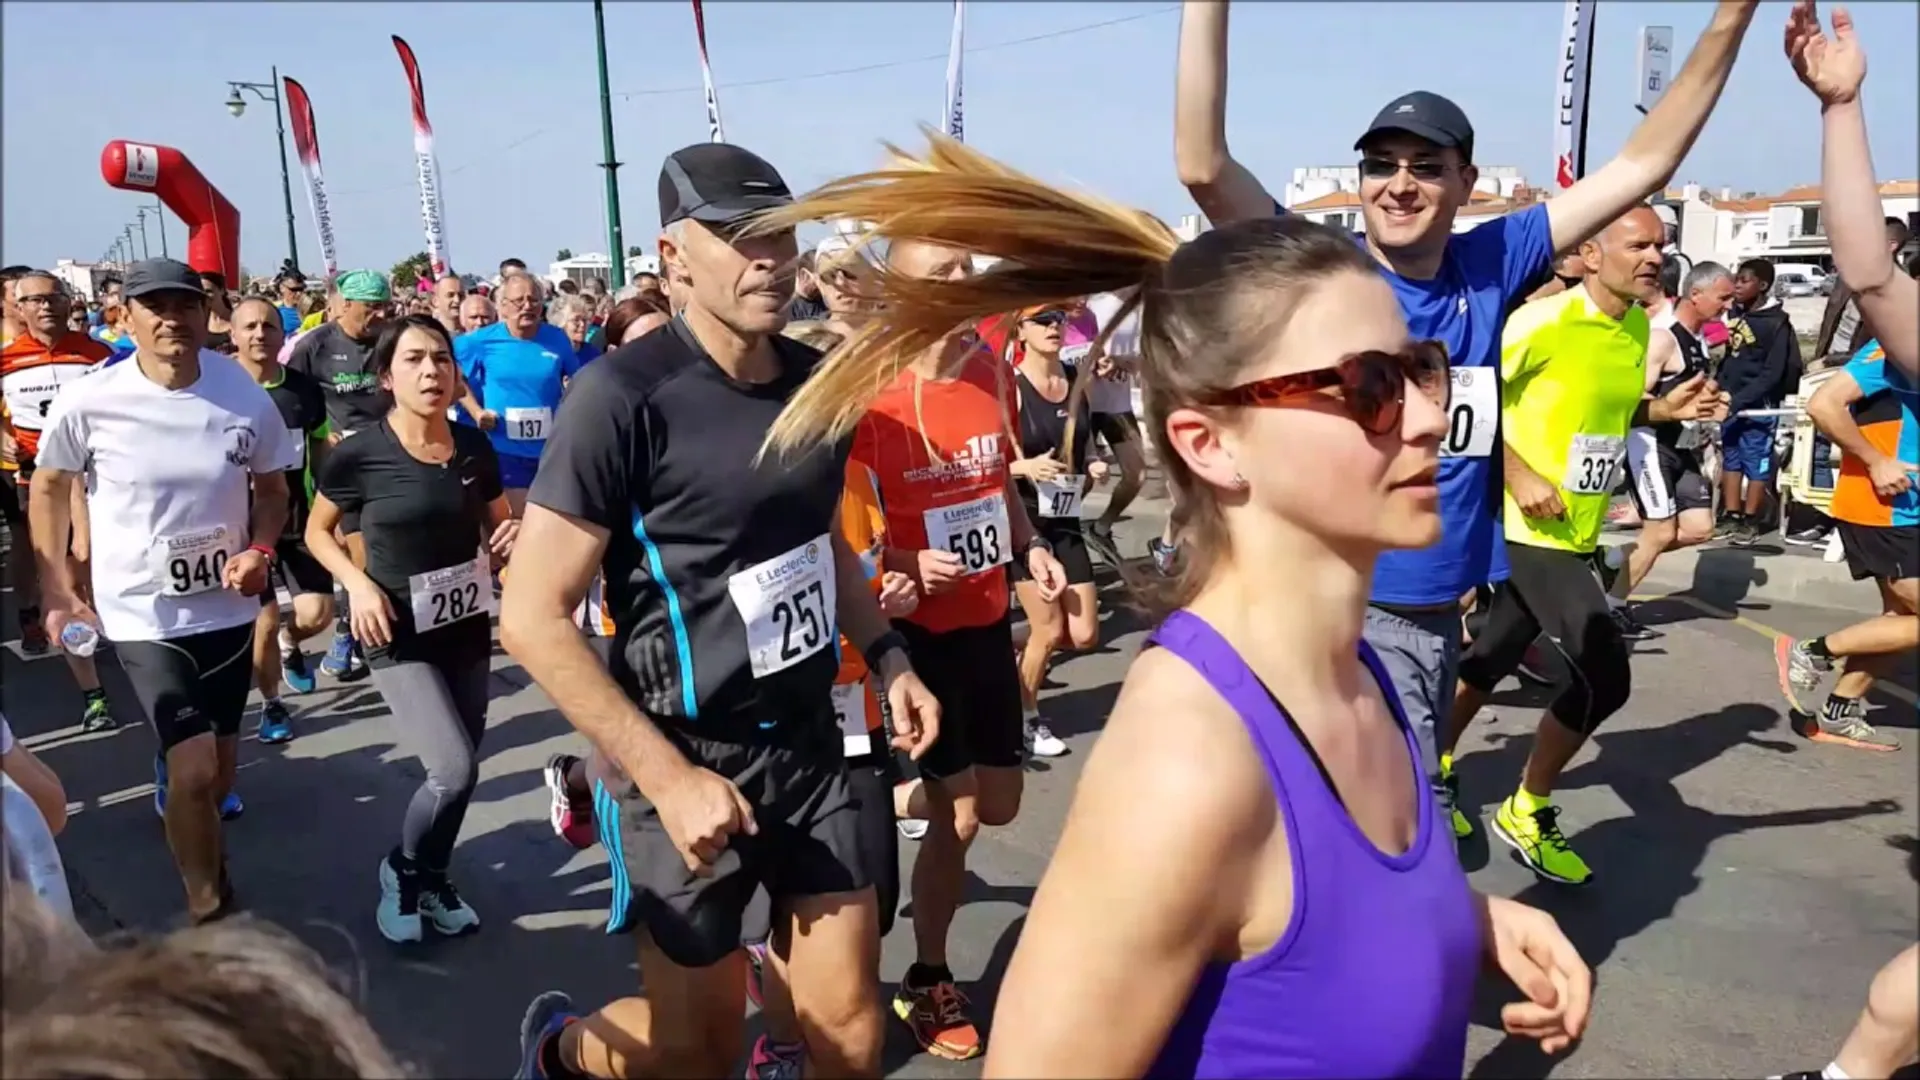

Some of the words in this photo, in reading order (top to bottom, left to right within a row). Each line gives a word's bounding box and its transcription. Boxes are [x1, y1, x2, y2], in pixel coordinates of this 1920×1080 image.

[518, 420, 542, 438] 137
[1579, 457, 1616, 491] 337
[1051, 491, 1075, 516] 477
[949, 524, 1000, 570] 593
[170, 549, 228, 593] 940
[431, 581, 480, 626] 282
[772, 580, 830, 662] 257
